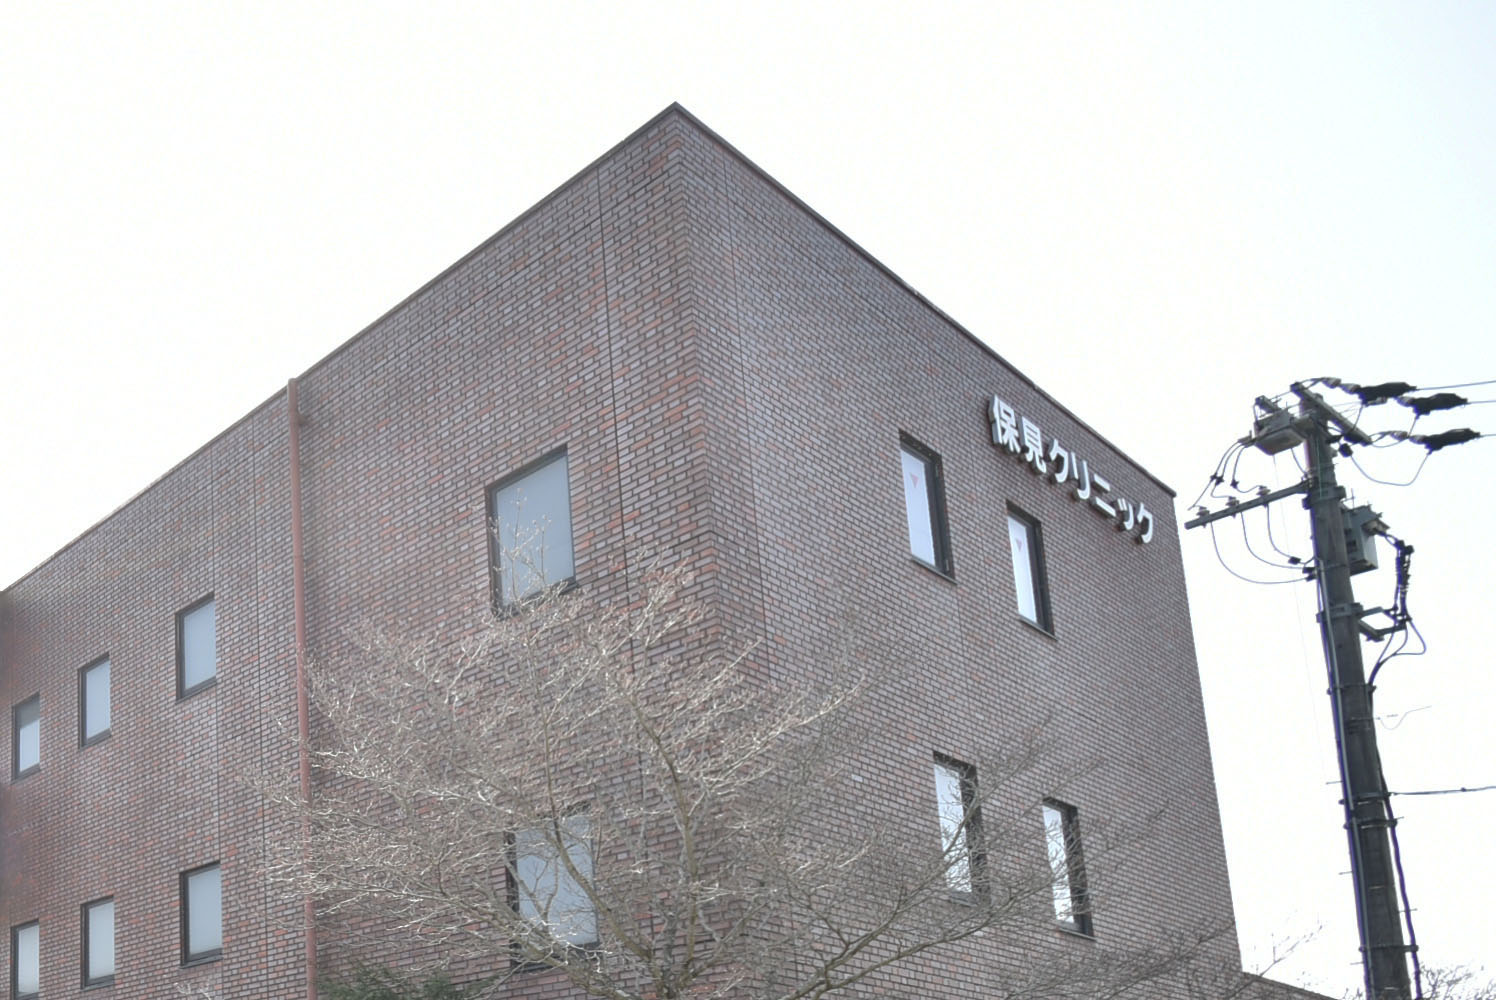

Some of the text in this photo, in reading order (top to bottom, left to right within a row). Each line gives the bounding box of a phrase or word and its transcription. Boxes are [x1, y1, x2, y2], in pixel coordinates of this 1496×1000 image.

[989, 395, 1154, 544] 保見クリニック
